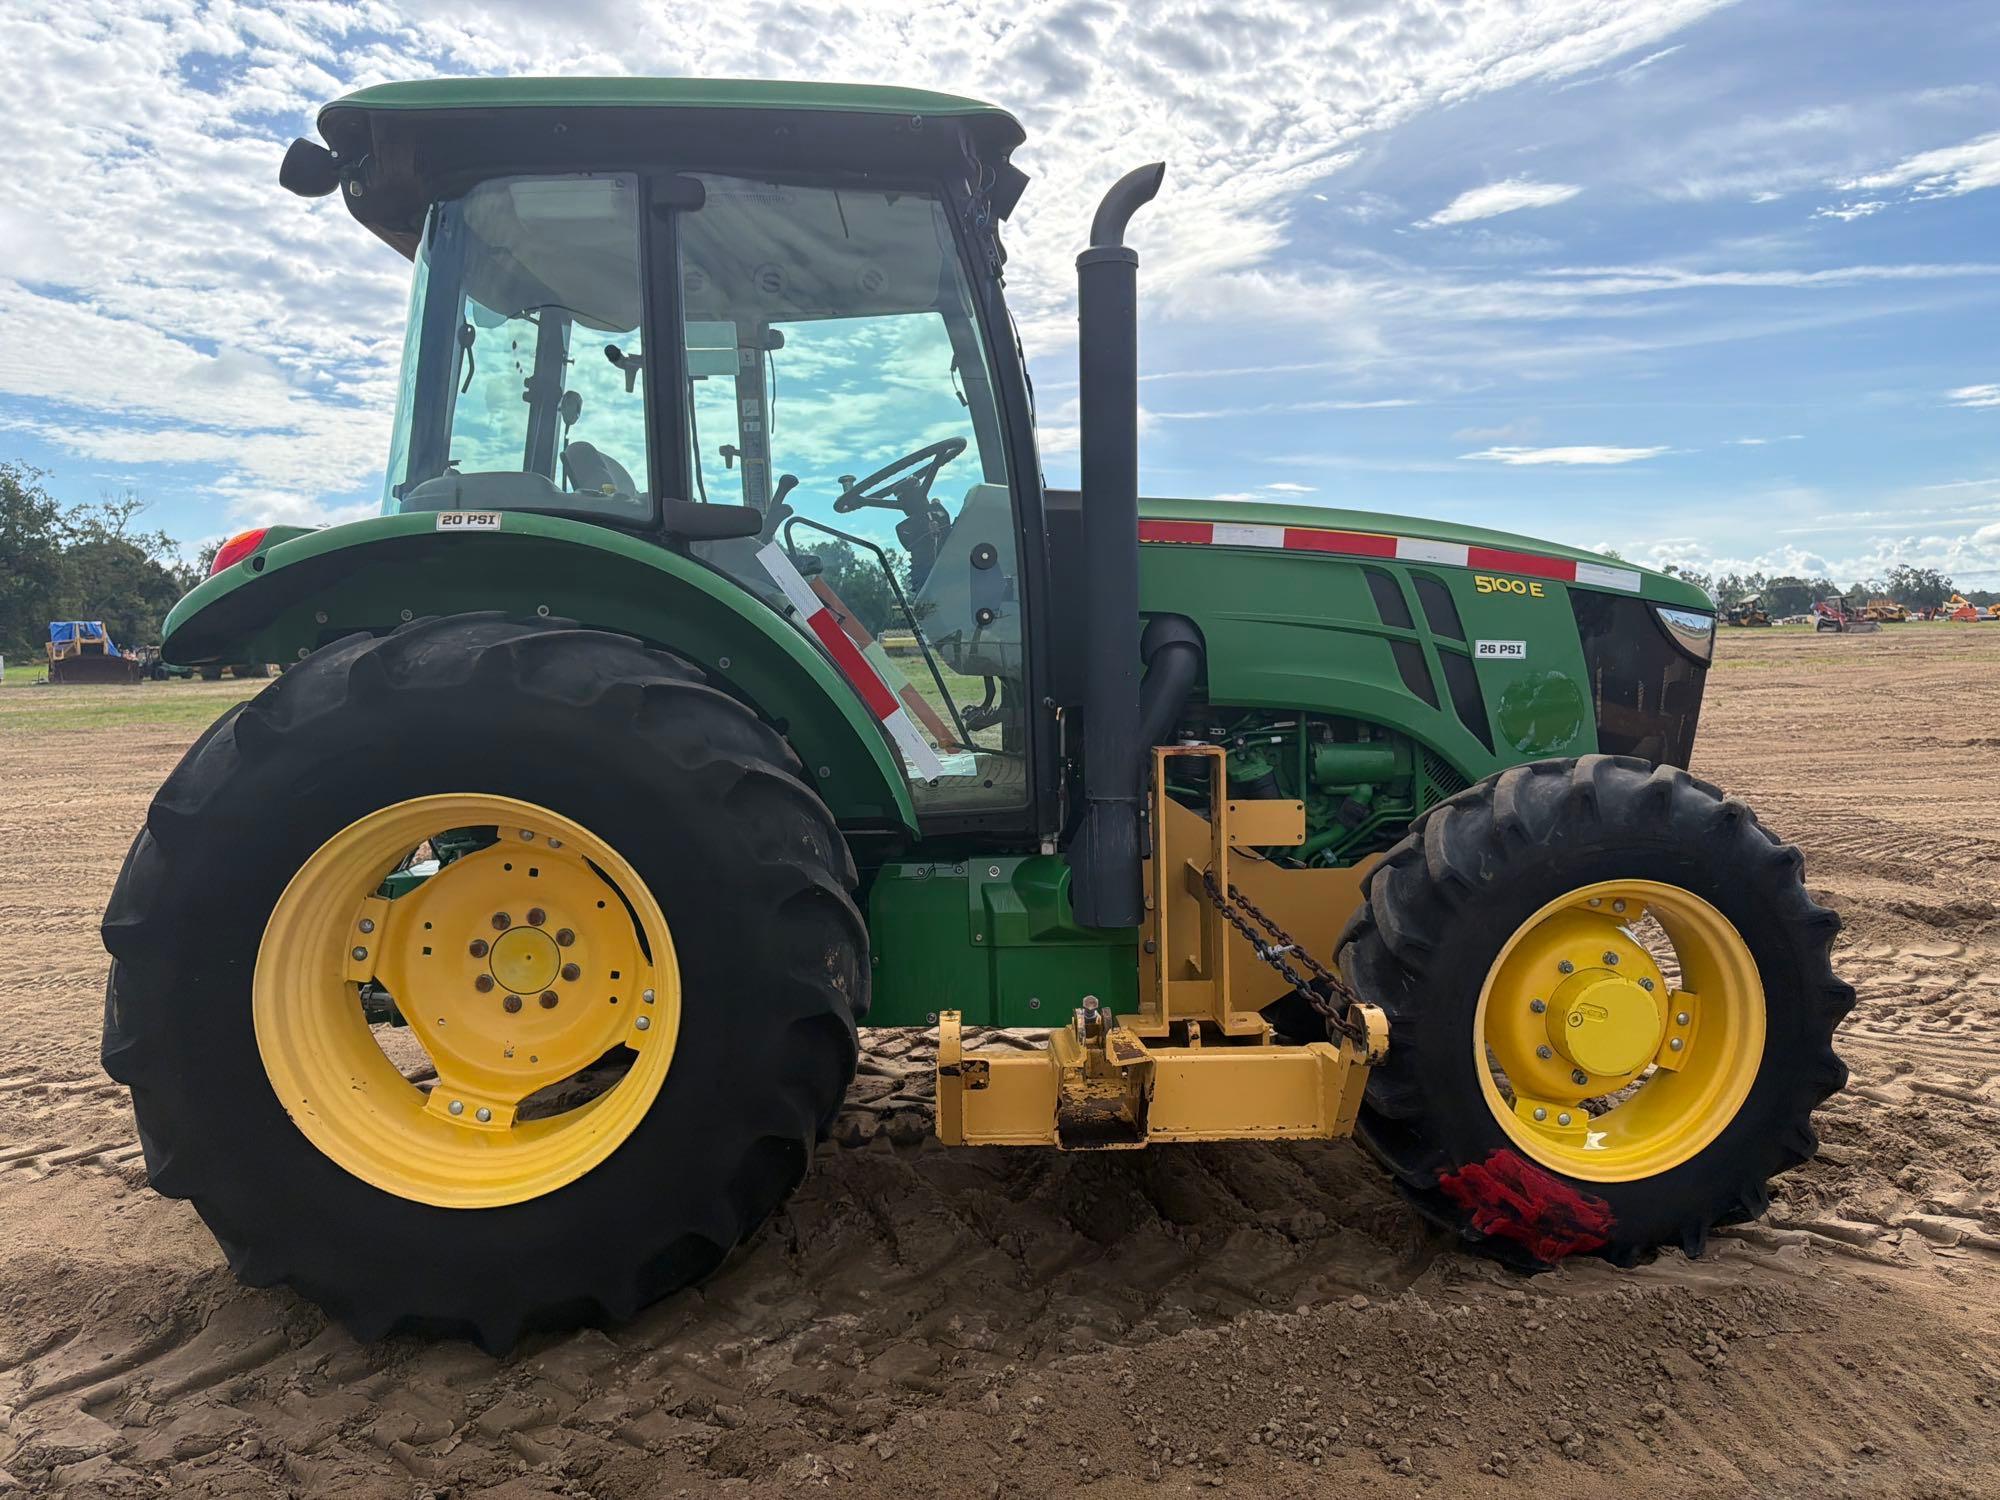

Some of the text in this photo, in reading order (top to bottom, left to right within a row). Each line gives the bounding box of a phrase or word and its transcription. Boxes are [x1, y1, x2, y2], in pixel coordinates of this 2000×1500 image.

[442, 515, 495, 525] 20 PSI
[1474, 575, 1545, 598] 5100 E
[1480, 644, 1522, 655] 26 PSI
